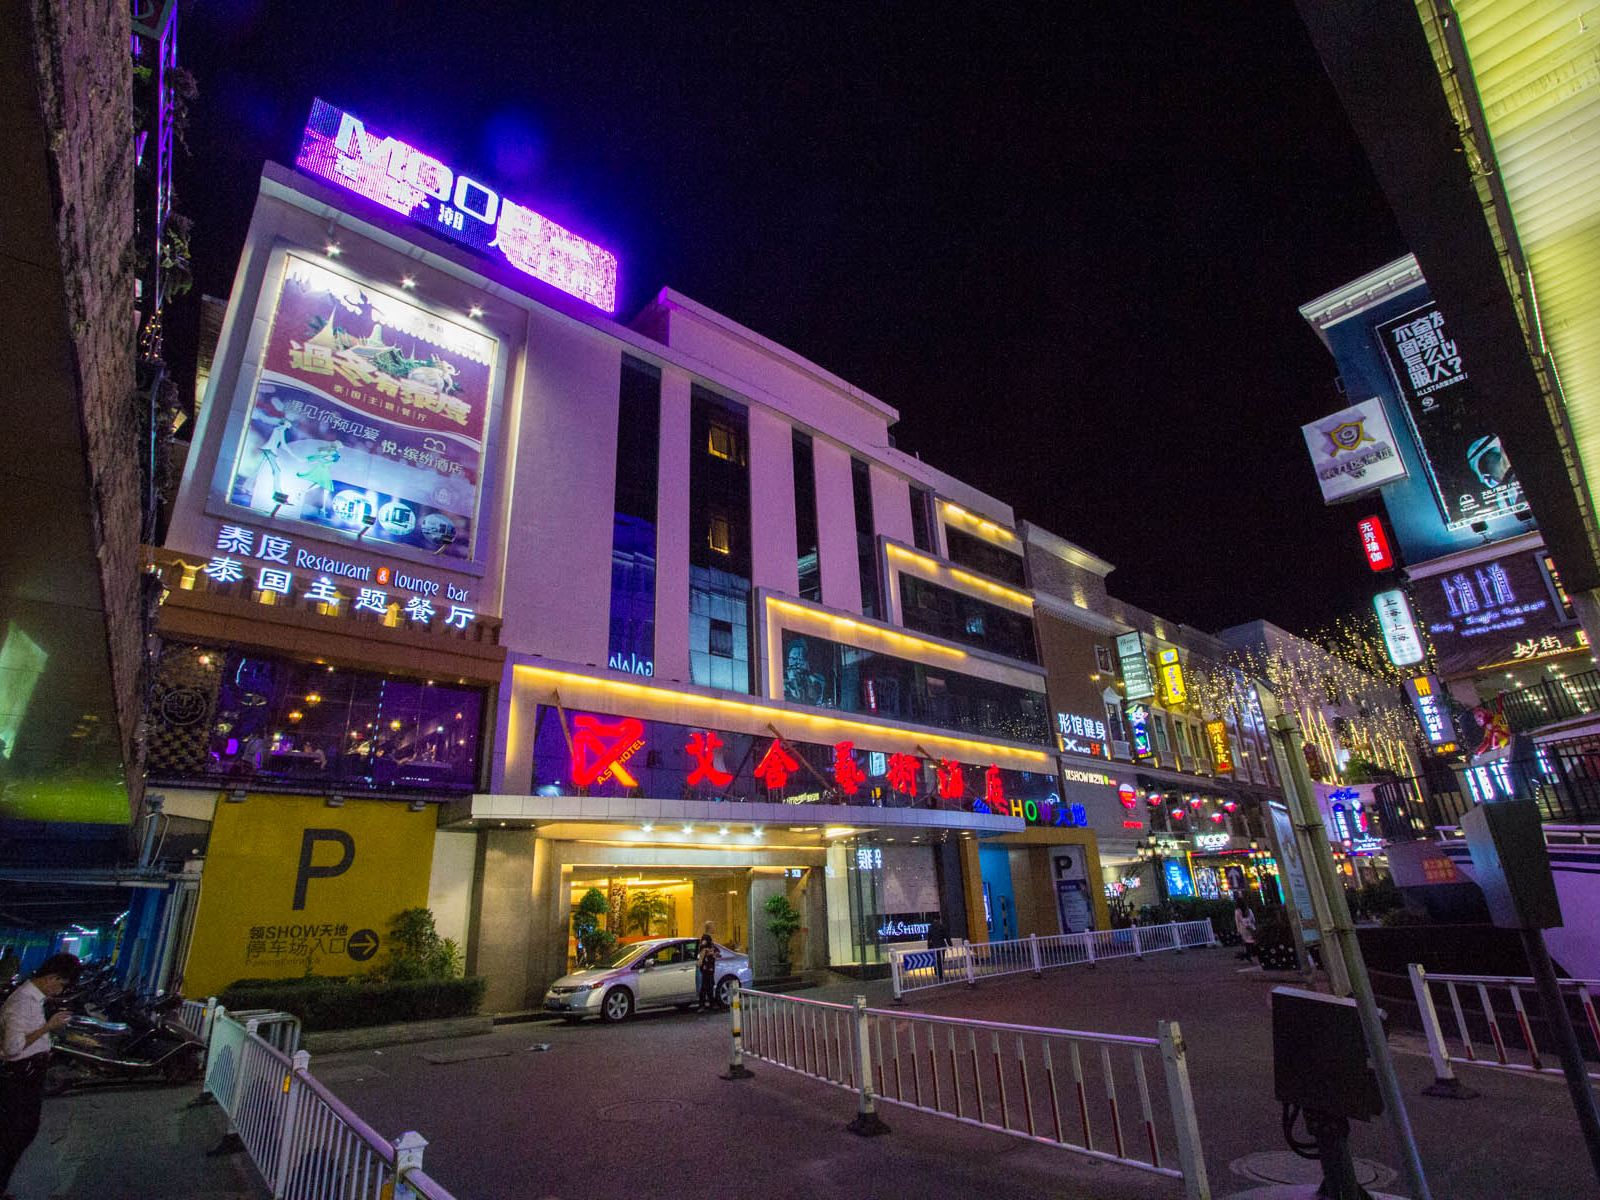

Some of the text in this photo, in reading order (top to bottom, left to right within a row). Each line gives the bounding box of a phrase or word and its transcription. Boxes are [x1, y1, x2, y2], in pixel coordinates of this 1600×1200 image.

[216, 524, 293, 565] 泰度
[204, 556, 476, 629] 泰国主题餐厅
[295, 549, 372, 582] Restaurant
[394, 573, 440, 596] lounge
[447, 582, 470, 603] bar
[1058, 713, 1106, 741] 形馆健身
[292, 828, 356, 911] P
[1053, 855, 1073, 879] P
